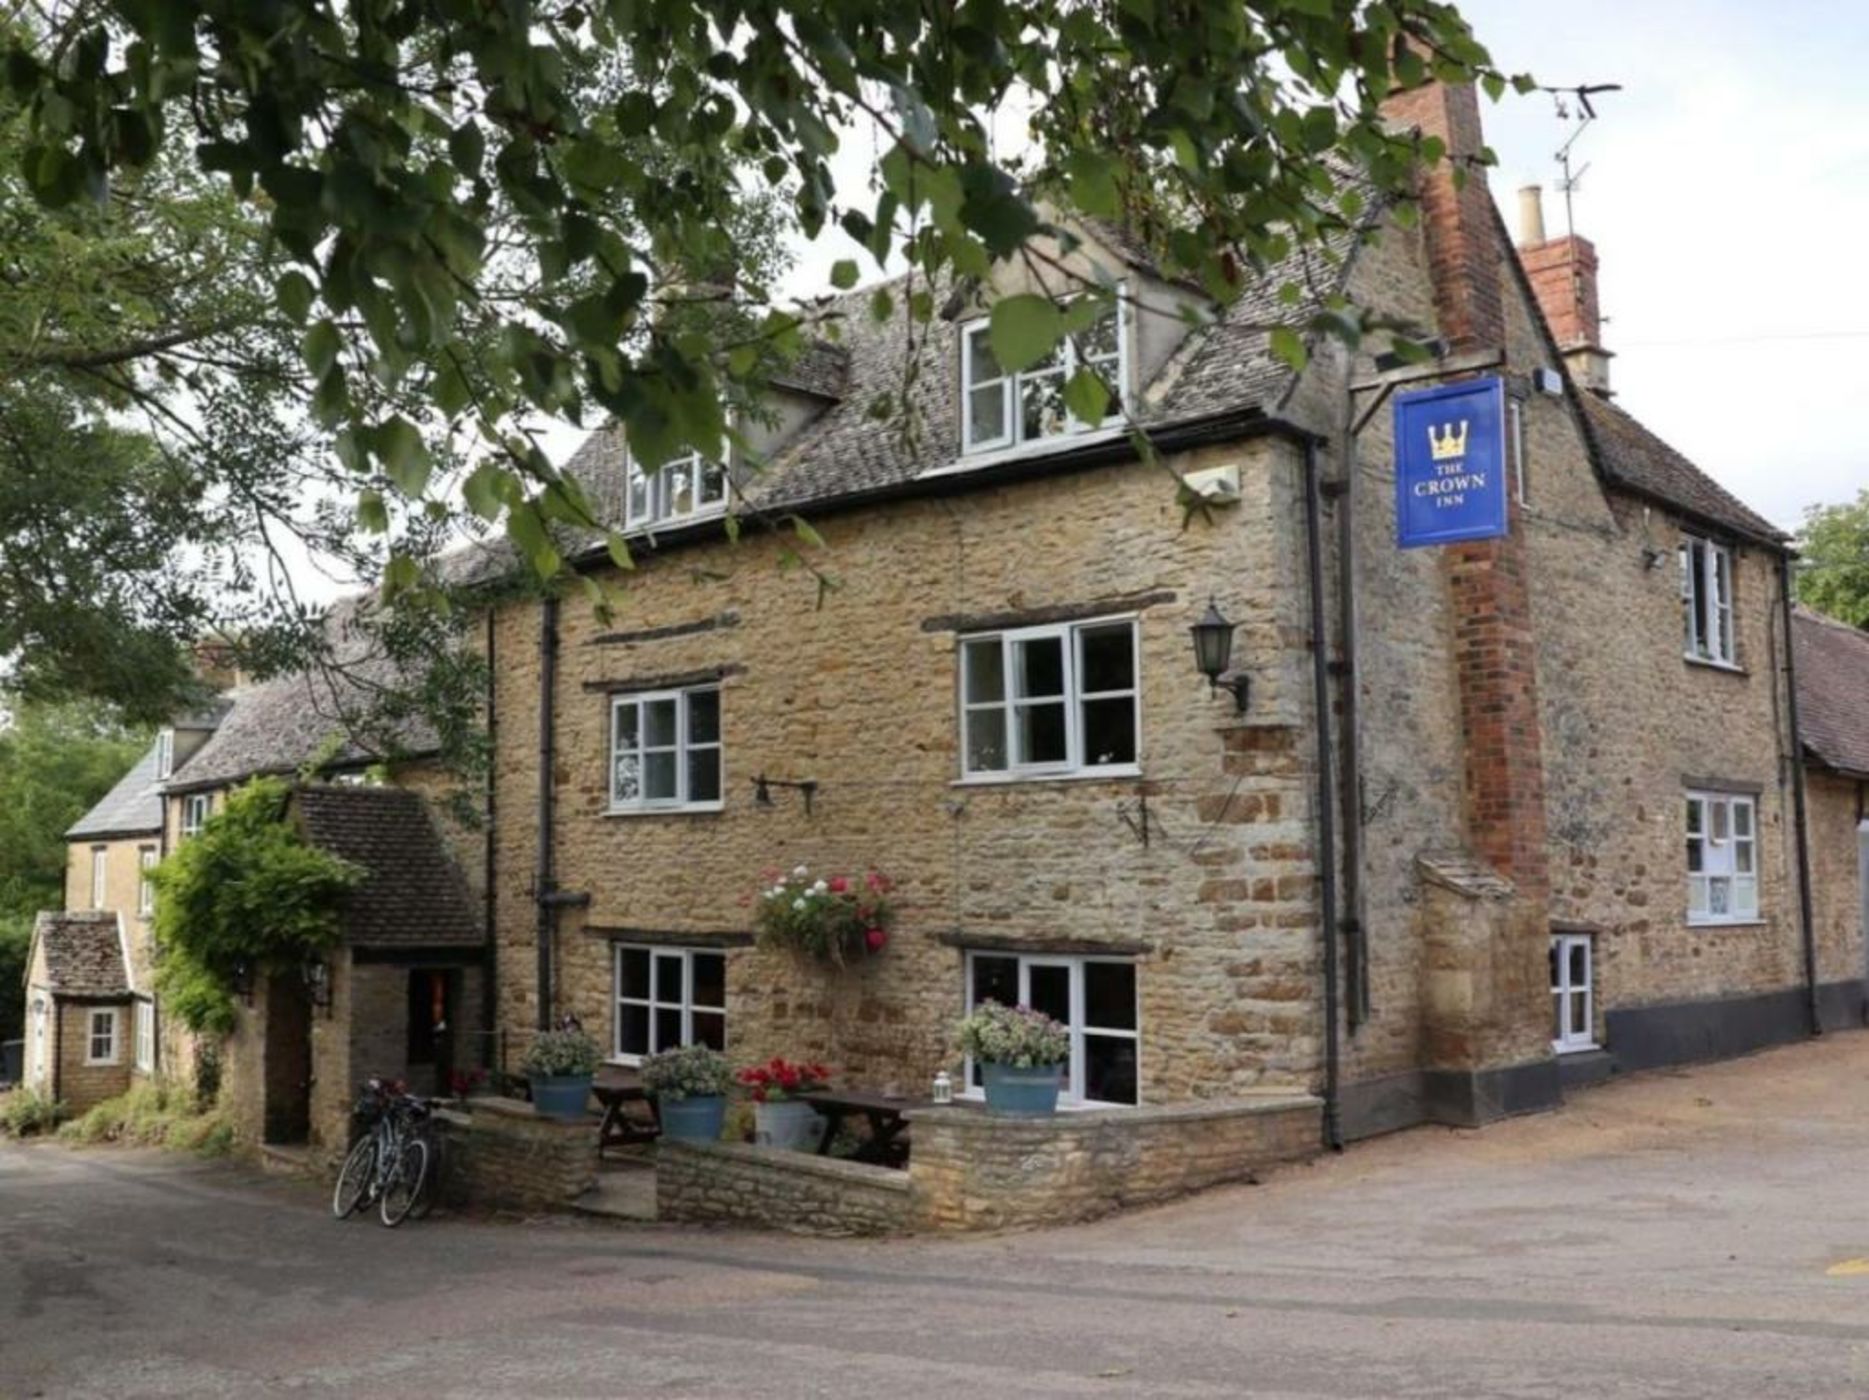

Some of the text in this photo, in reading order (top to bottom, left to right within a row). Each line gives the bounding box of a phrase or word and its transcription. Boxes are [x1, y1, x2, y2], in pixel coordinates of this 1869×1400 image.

[1436, 463, 1464, 476] THE
[1414, 473, 1486, 497] CROWN
[1436, 494, 1464, 508] INN
